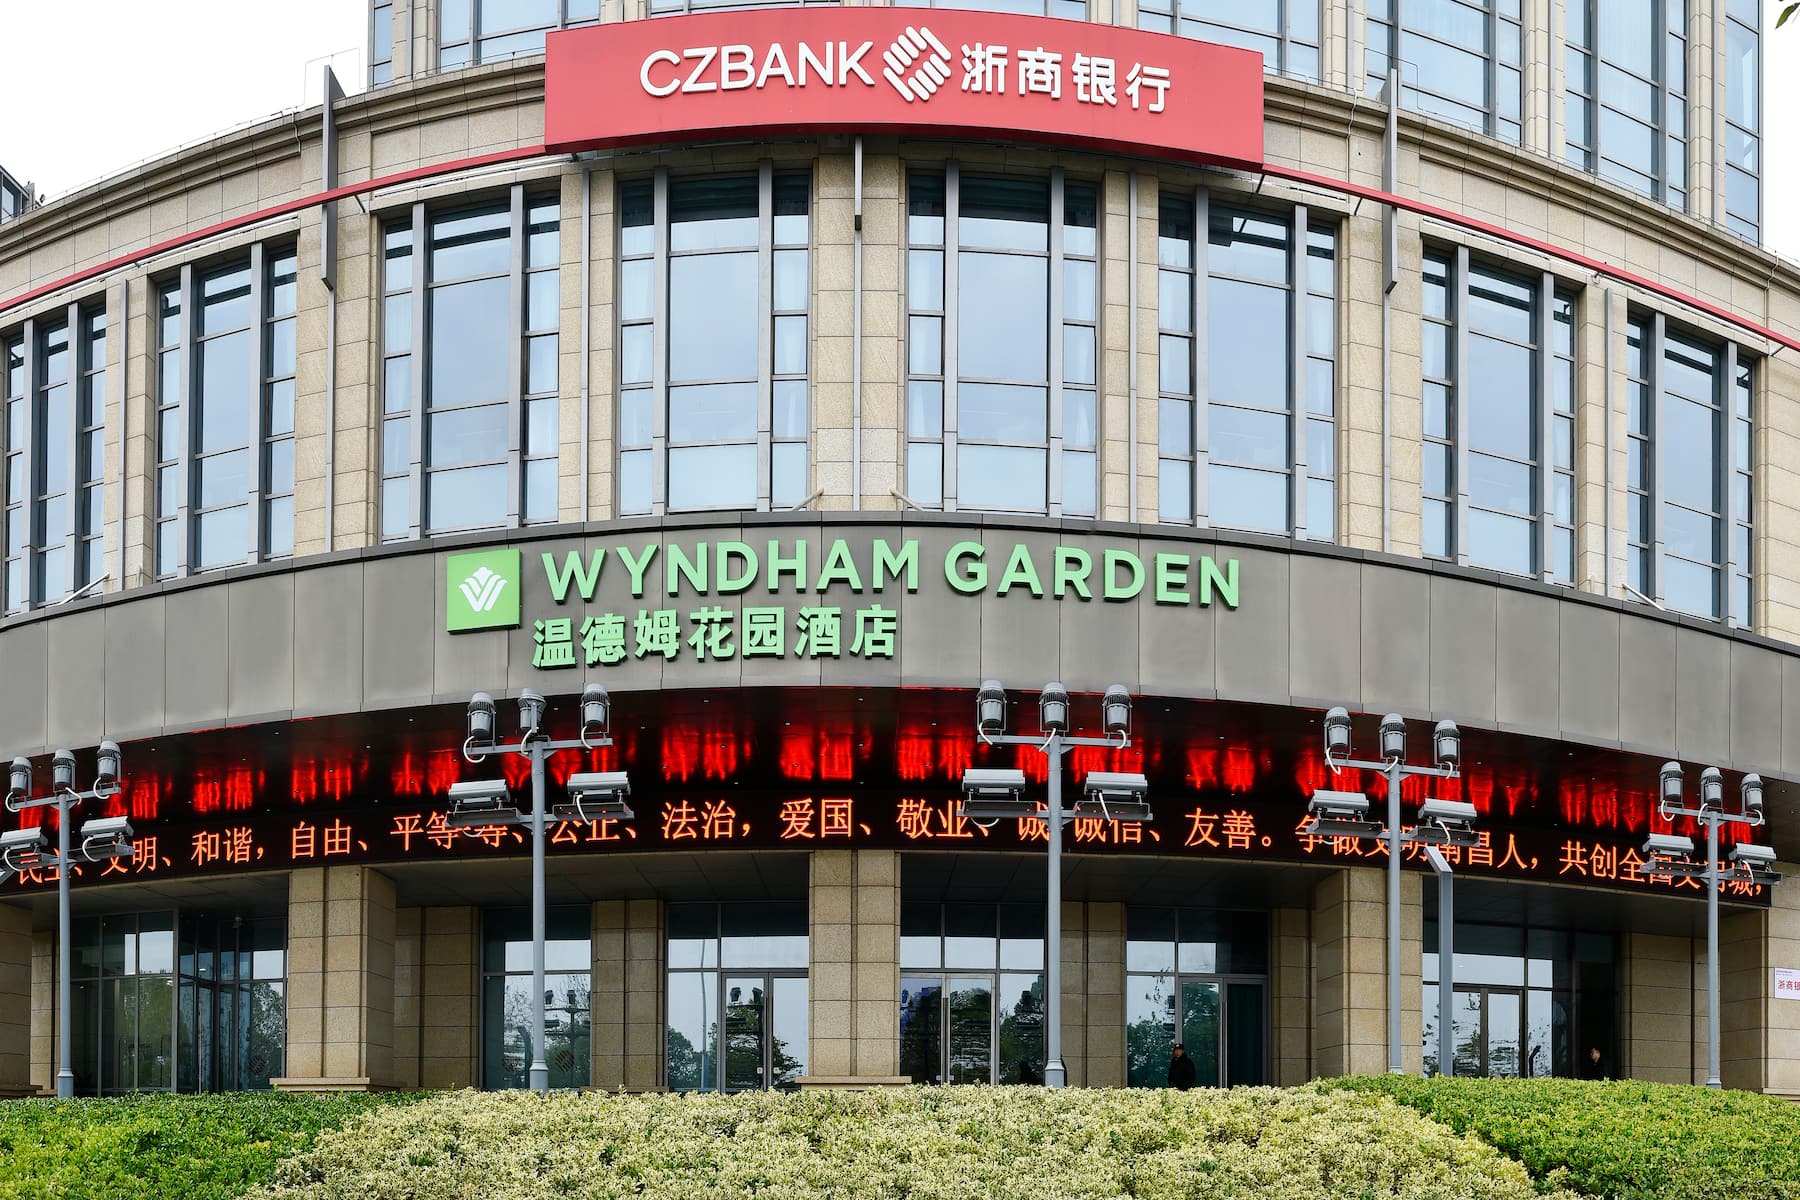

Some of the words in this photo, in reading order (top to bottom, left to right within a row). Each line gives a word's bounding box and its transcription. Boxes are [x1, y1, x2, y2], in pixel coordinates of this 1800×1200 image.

[639, 41, 875, 97] CZBANK
[961, 43, 1171, 113] 浙商银行
[541, 539, 919, 603] WYNDHAM
[944, 541, 1240, 608] GARDEN
[531, 603, 898, 670] 温德姆花园酒店
